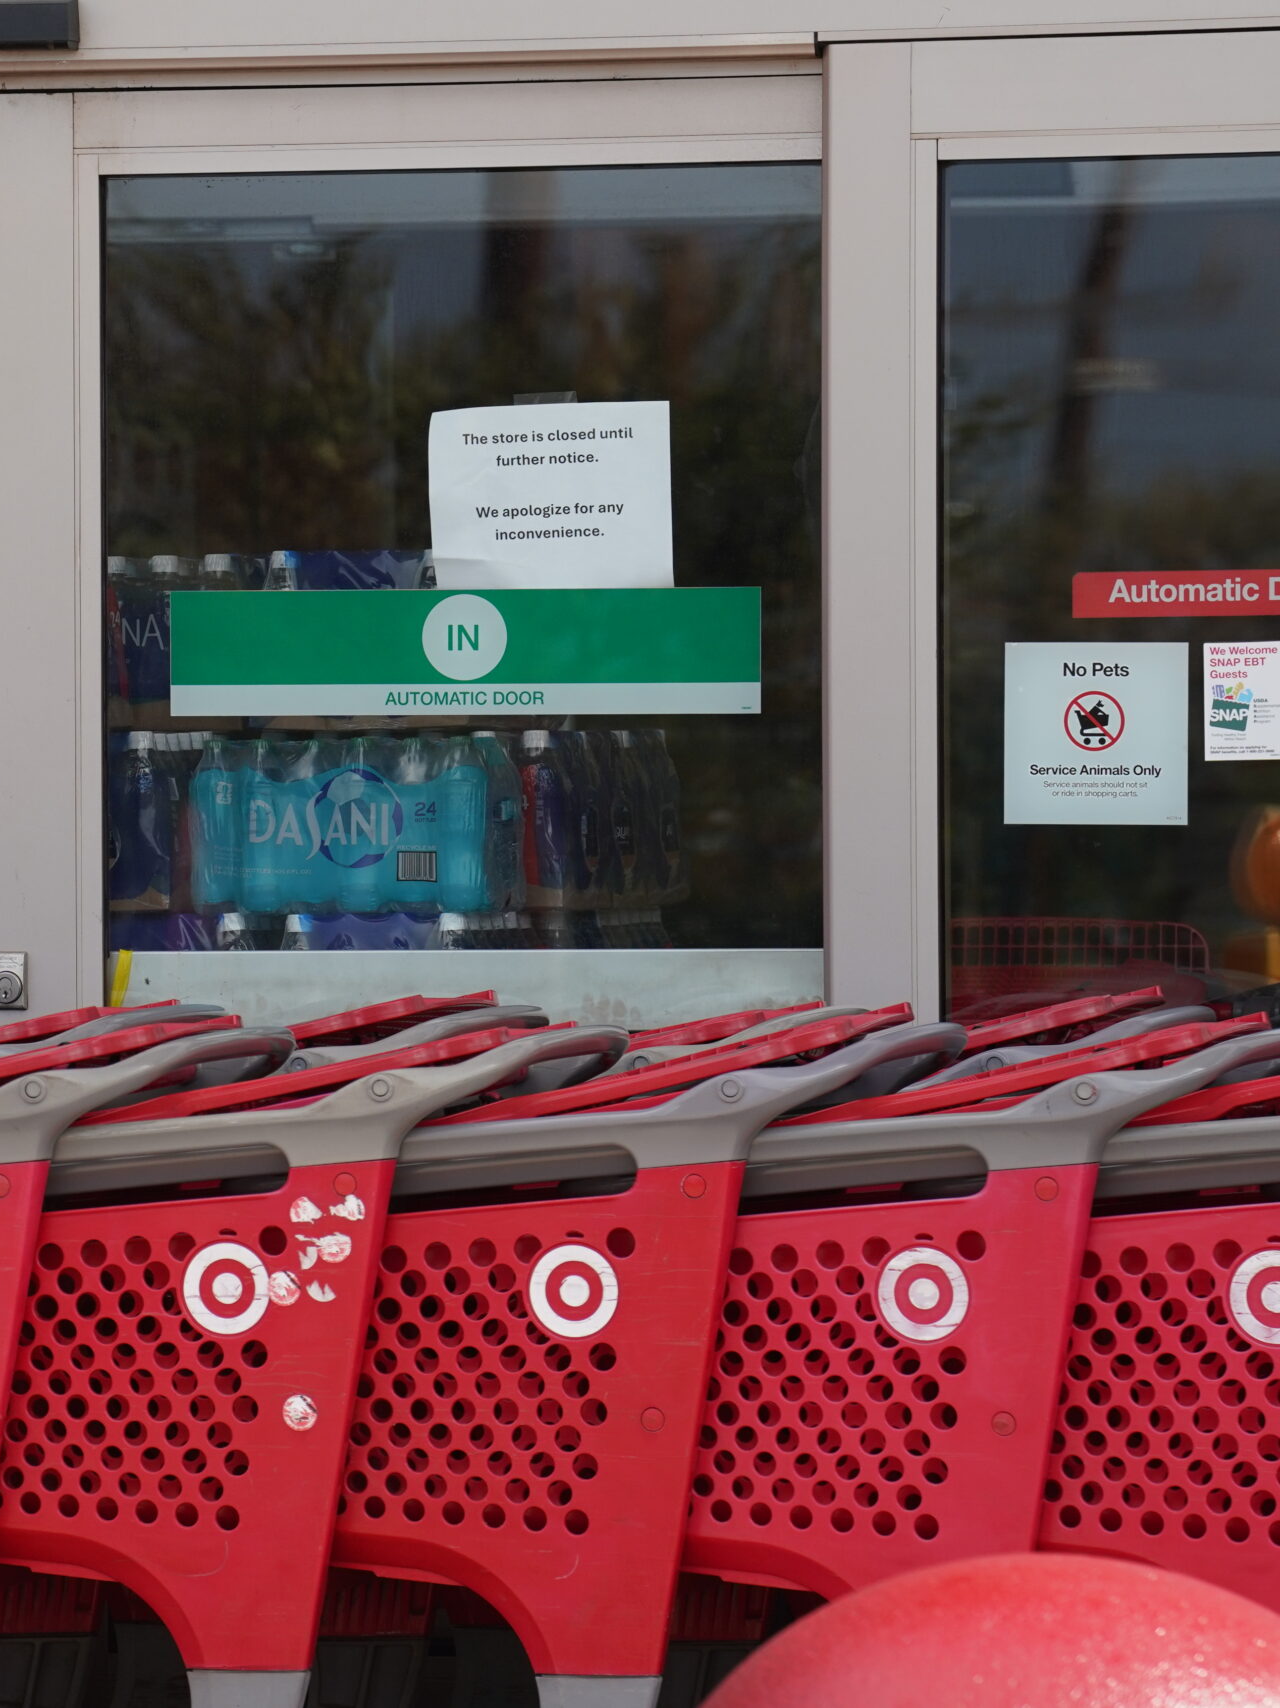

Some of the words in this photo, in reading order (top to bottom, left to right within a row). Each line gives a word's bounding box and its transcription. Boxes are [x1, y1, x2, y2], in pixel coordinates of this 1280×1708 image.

[462, 433, 488, 446] The
[491, 432, 528, 445] store
[531, 430, 544, 442] is
[547, 428, 596, 442] closed
[599, 426, 634, 440] until
[495, 453, 546, 467] further
[548, 452, 599, 465] notice.
[475, 506, 499, 519] We
[502, 503, 571, 520] apologize
[573, 502, 595, 515] for
[598, 502, 624, 517] any
[495, 526, 605, 541] inconvenience.
[1108, 577, 1260, 603] Automatic
[447, 624, 479, 652] IN
[1209, 646, 1226, 656] We
[1228, 645, 1278, 656] Welcome
[1063, 662, 1087, 677] No
[1092, 662, 1130, 677] Pets
[1209, 657, 1241, 668] SNAP
[1243, 656, 1266, 667] EBT
[1209, 669, 1248, 679] Guests
[385, 690, 488, 706] AUTOMATIC
[493, 690, 545, 706] DOOR
[1210, 708, 1248, 723] SNAP
[1030, 764, 1077, 776] Service
[1080, 764, 1130, 776] Animals
[1133, 764, 1162, 779] Only
[1043, 780, 1070, 788] Service
[1072, 780, 1099, 788] animals
[1100, 780, 1124, 788] should
[1061, 789, 1075, 797] ride
[1076, 789, 1083, 797] in
[1084, 790, 1118, 799] shopping
[1119, 790, 1138, 798] carts.
[414, 801, 437, 818] 24
[249, 791, 389, 861] DASANI
